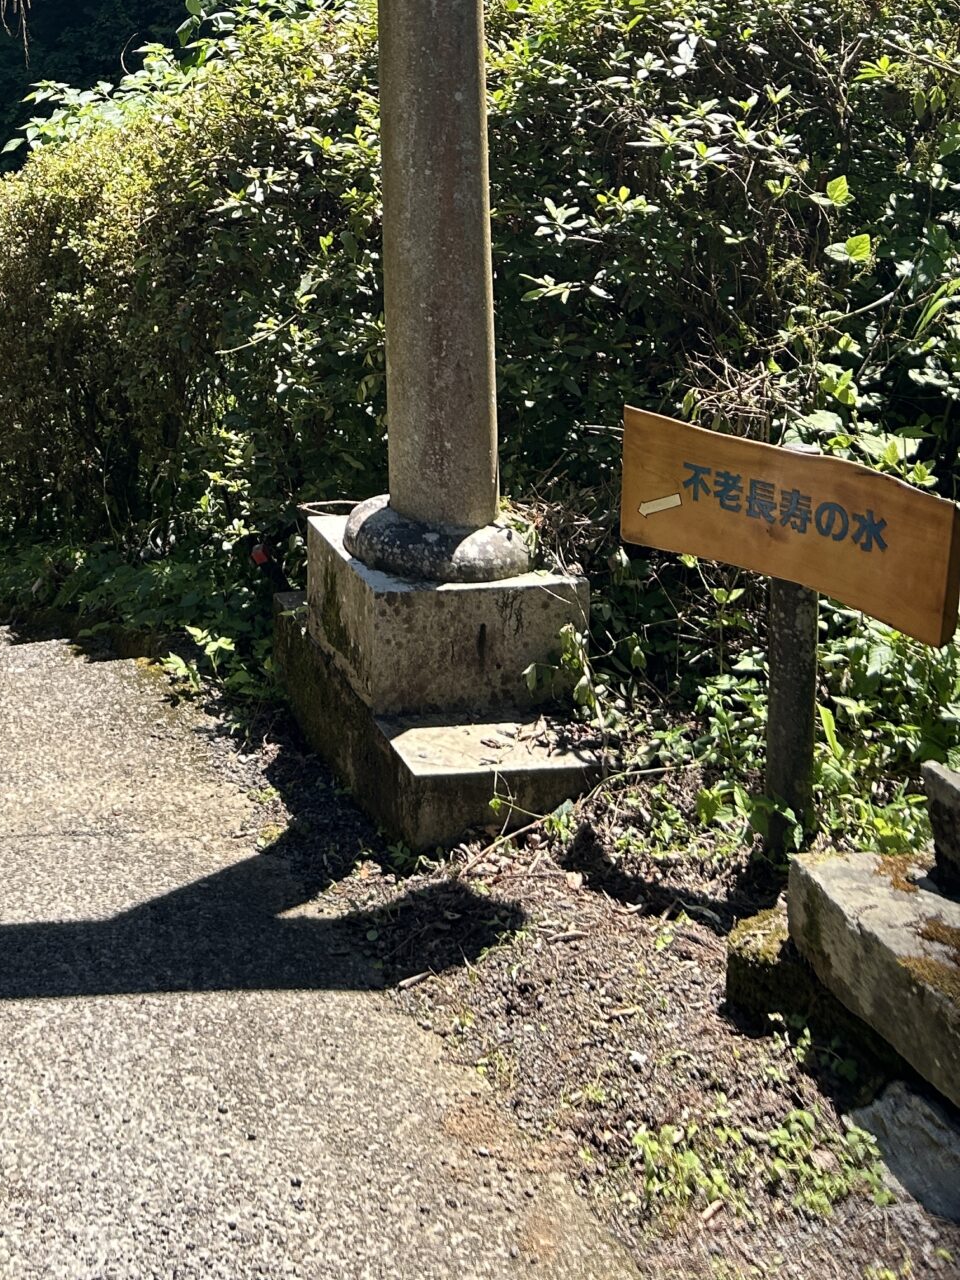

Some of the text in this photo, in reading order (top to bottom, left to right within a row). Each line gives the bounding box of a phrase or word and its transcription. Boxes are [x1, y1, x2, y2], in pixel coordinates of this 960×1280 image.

[682, 461, 888, 552] 不老長寿の水
